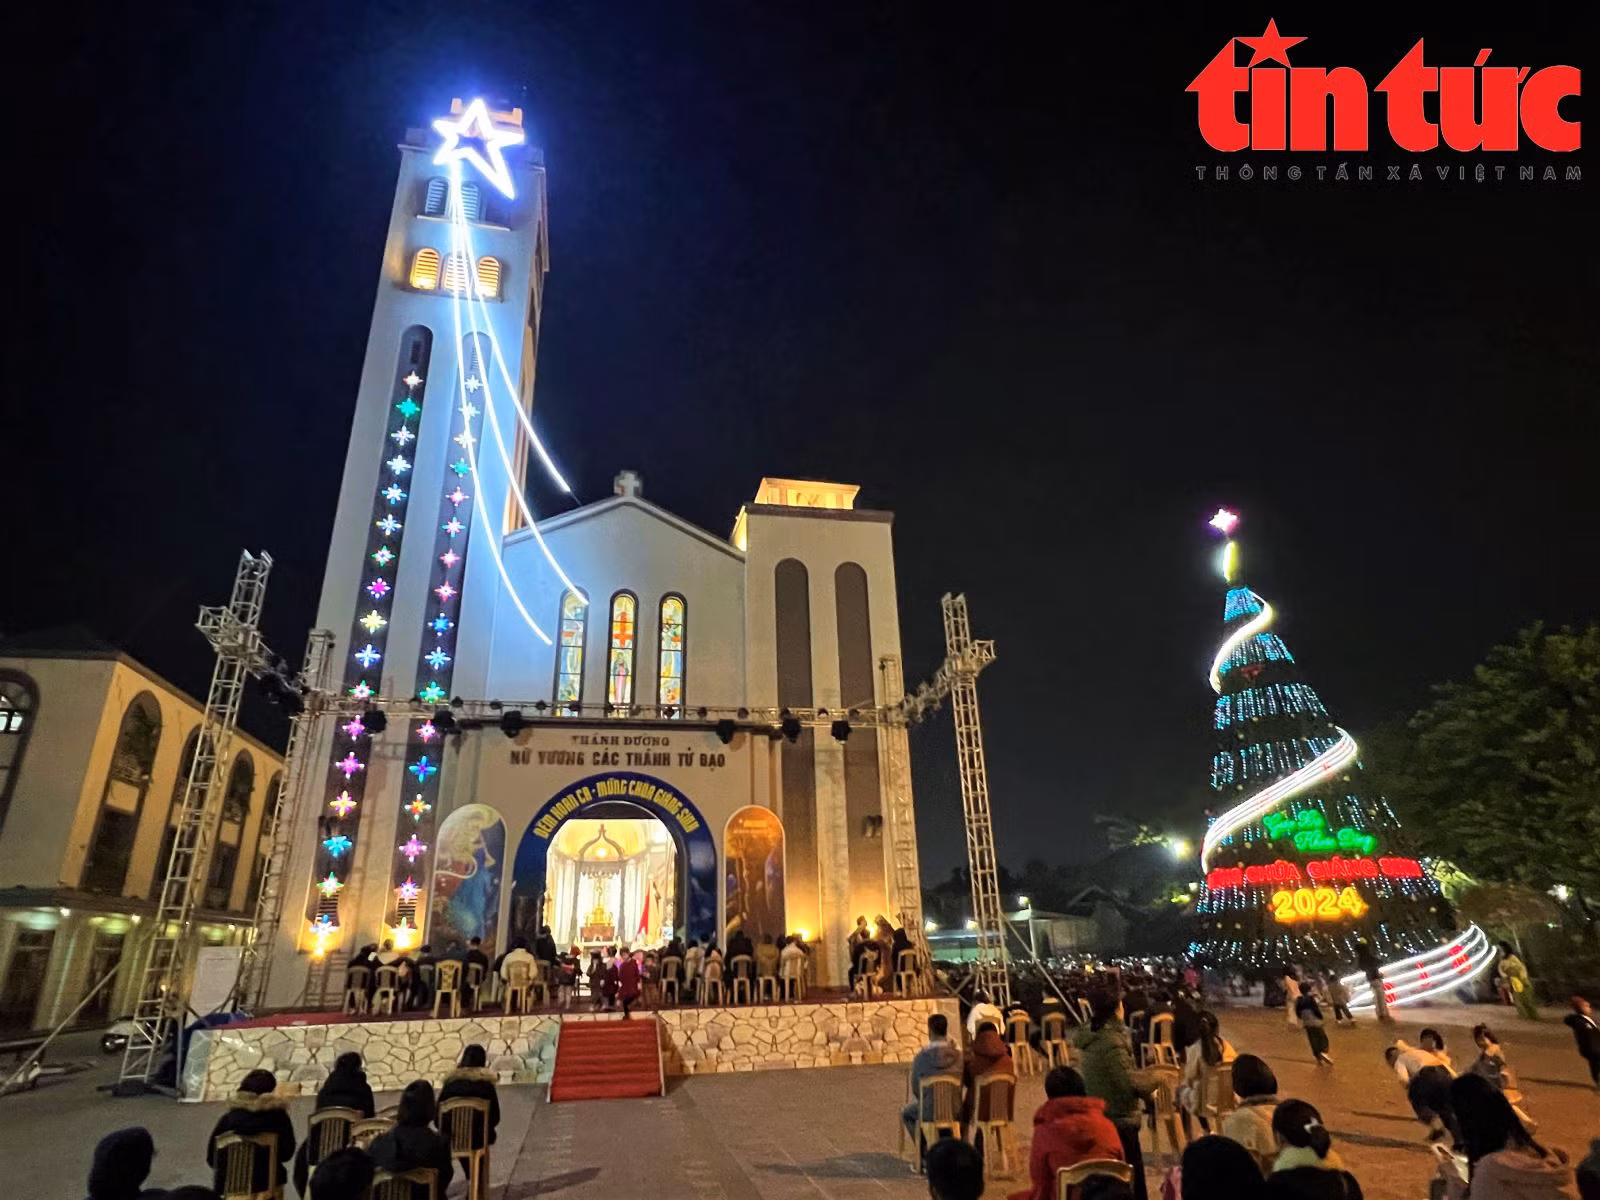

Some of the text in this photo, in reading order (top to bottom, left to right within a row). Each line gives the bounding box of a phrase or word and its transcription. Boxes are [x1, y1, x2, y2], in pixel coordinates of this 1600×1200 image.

[571, 731, 620, 746] THÁNH
[592, 747, 620, 766] CÁC
[626, 748, 671, 766] THÁNH
[1272, 886, 1364, 922] 2024
